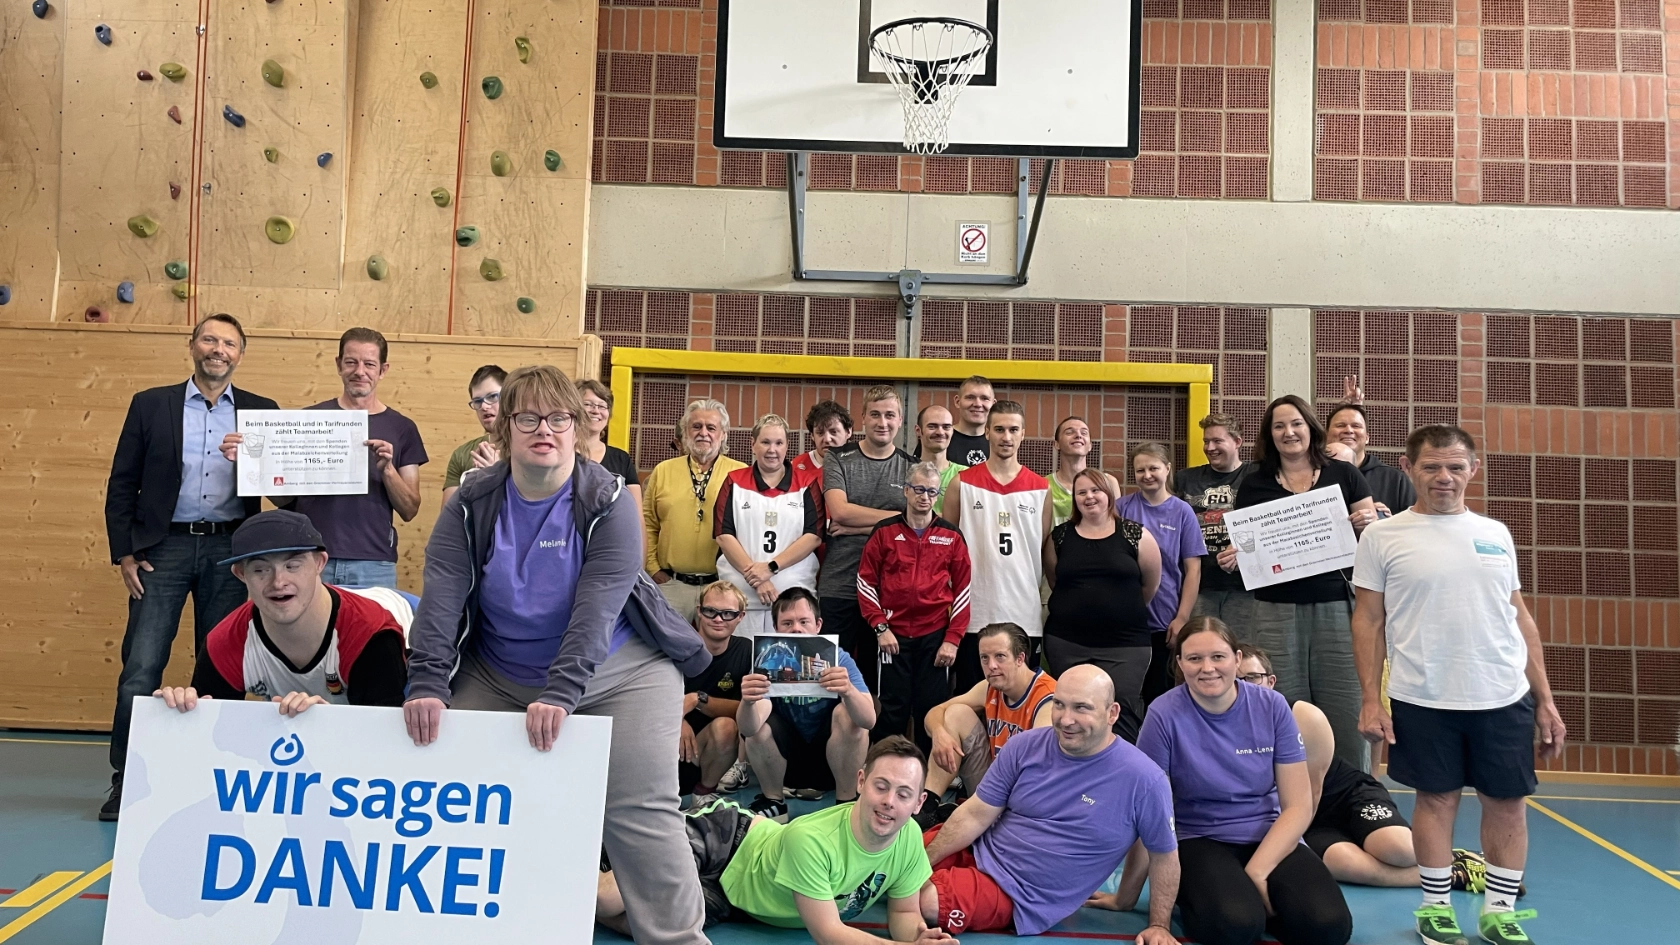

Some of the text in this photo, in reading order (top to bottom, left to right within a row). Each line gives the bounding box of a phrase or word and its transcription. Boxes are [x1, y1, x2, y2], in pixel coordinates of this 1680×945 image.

[1249, 510, 1282, 522] Basketball
[1302, 496, 1338, 509] Tarifrunden
[1277, 510, 1313, 523] Teamarbeit!
[763, 530, 777, 554] 3
[999, 532, 1013, 556] 5
[1294, 540, 1314, 548] 1165,-
[1315, 535, 1330, 543] Euro
[213, 733, 512, 838] wir sagen
[1081, 794, 1096, 805] Tony
[201, 834, 506, 918] DANKE!
[948, 909, 966, 928] 62
